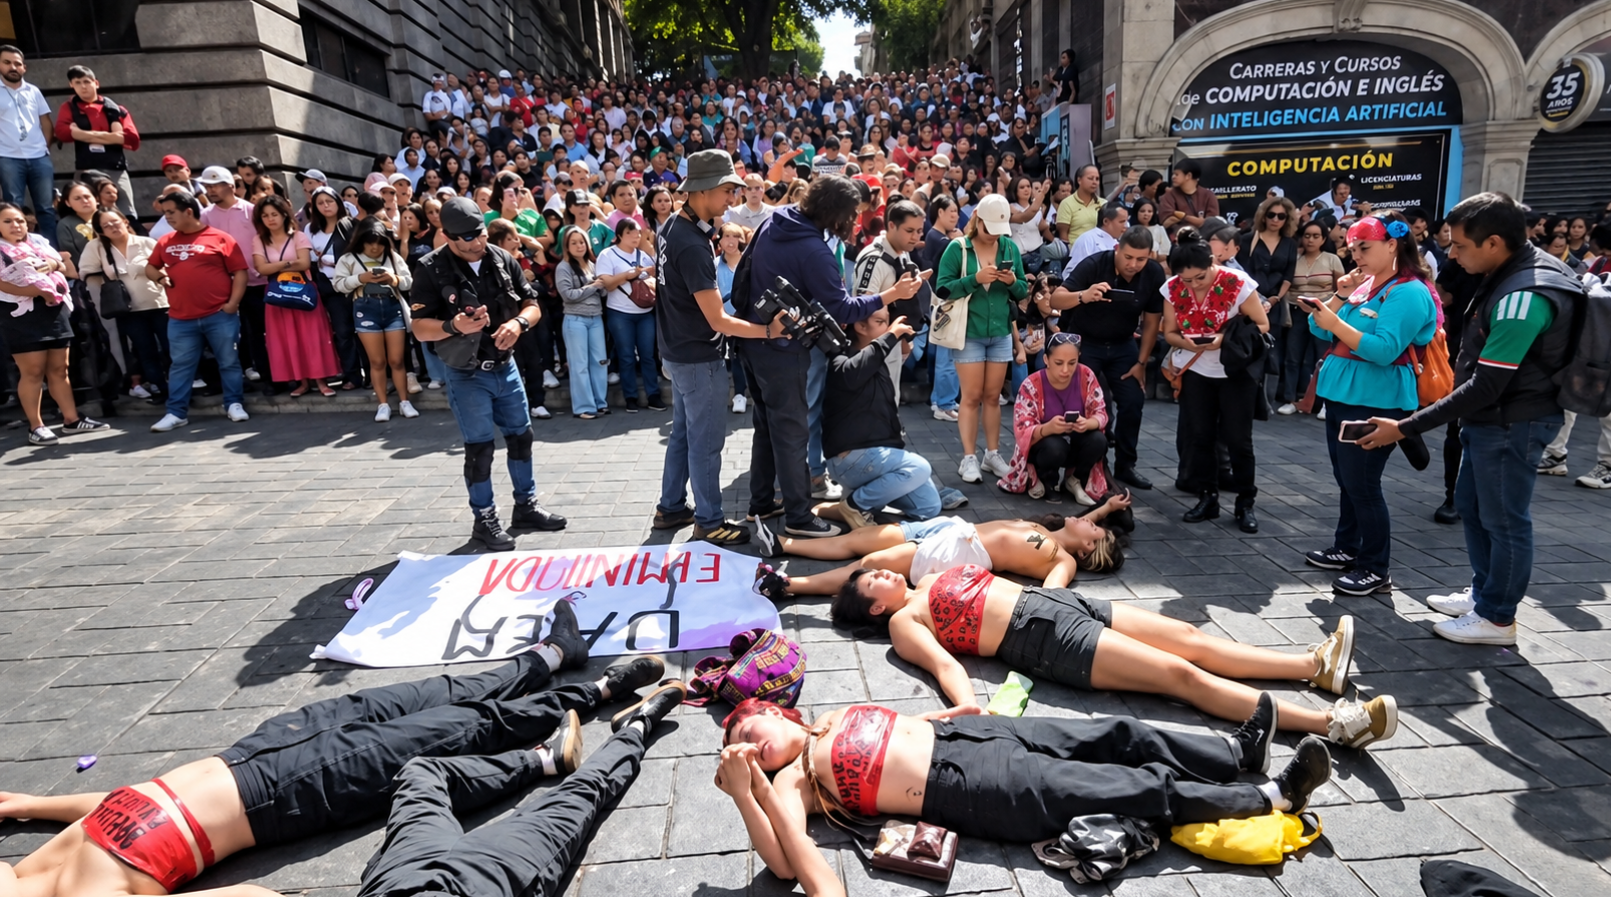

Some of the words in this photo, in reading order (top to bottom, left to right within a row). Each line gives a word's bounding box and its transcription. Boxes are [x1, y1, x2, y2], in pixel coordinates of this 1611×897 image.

[1205, 76, 1352, 104] COMPUTACIÓN
[1356, 78, 1370, 96] E
[1374, 69, 1445, 95] INGLÉS
[1546, 71, 1581, 99] 35
[1210, 106, 1340, 130] INTELIGENCIA
[1345, 101, 1447, 122] ARTIFICIAL
[1227, 149, 1393, 177] COMPUTACIÓN
